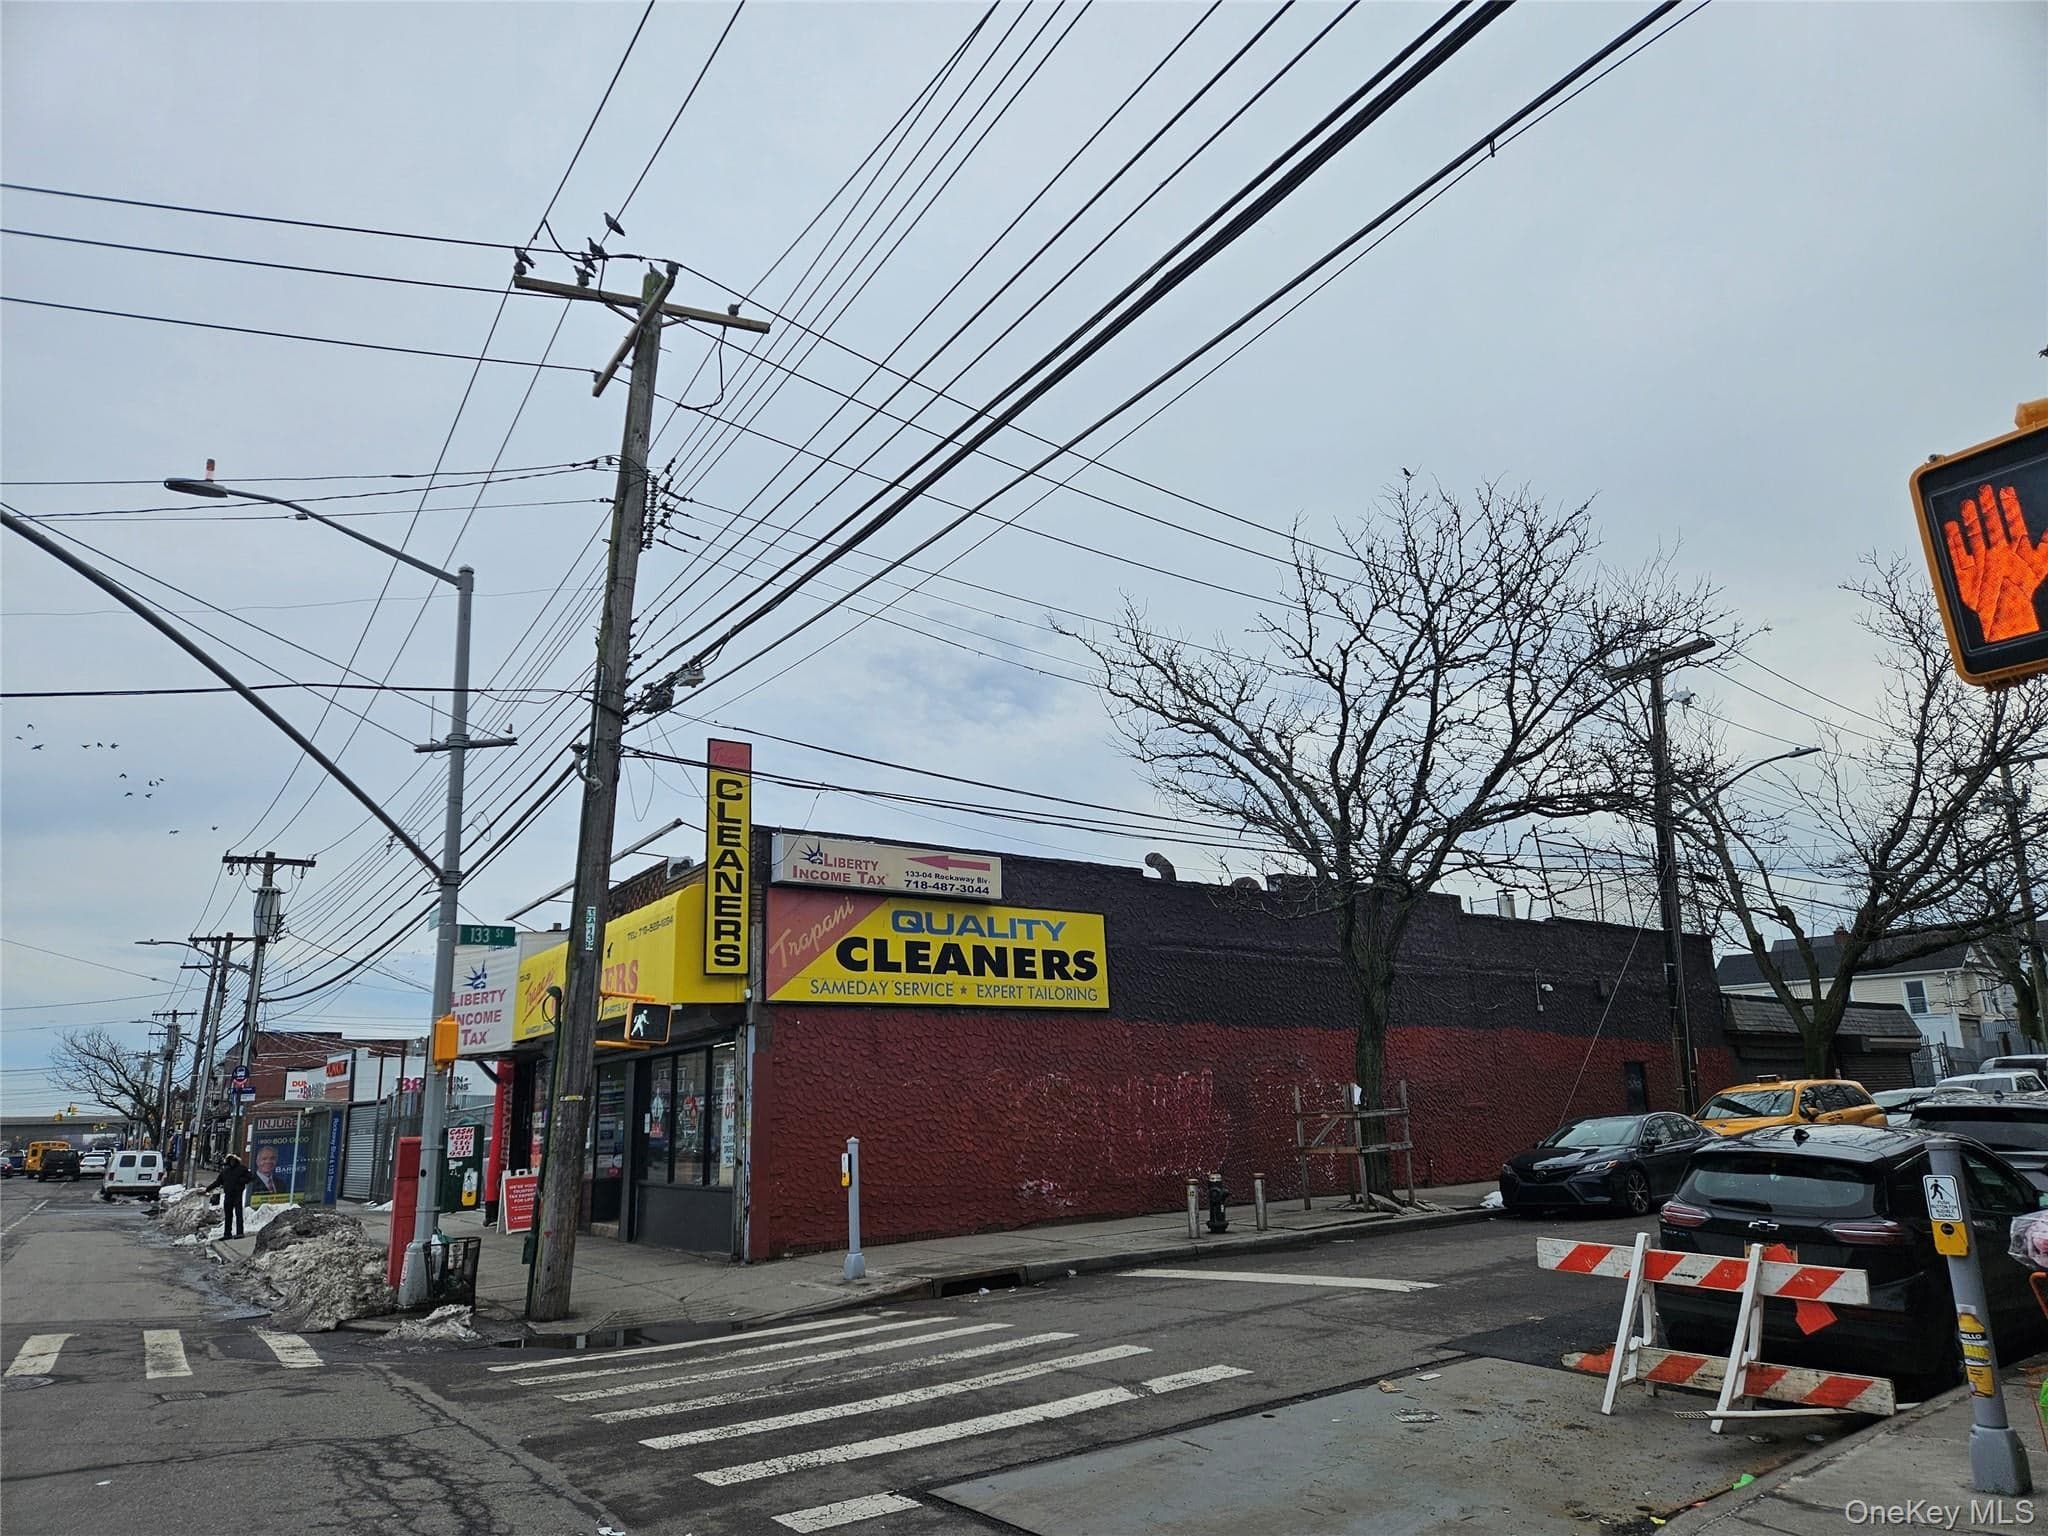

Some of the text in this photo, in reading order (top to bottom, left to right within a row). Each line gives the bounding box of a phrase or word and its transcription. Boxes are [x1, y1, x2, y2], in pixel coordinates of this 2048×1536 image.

[713, 778, 744, 967] CLEANERS
[823, 852, 879, 872] LIBERTY
[792, 865, 886, 887] INCOME TAX
[904, 870, 933, 879] 133-04
[934, 873, 975, 884] Rockaway
[904, 879, 990, 896] 718-487-3044
[470, 927, 491, 943] 133
[769, 896, 855, 969] Trapani
[891, 909, 1067, 942] QUALITY
[835, 936, 1099, 982] CLEANERS
[450, 988, 507, 1008] LIBERTY
[810, 979, 1098, 1002] SAMEDAY SERVICE EXPERT TAILORING
[461, 1028, 488, 1046] TAX
